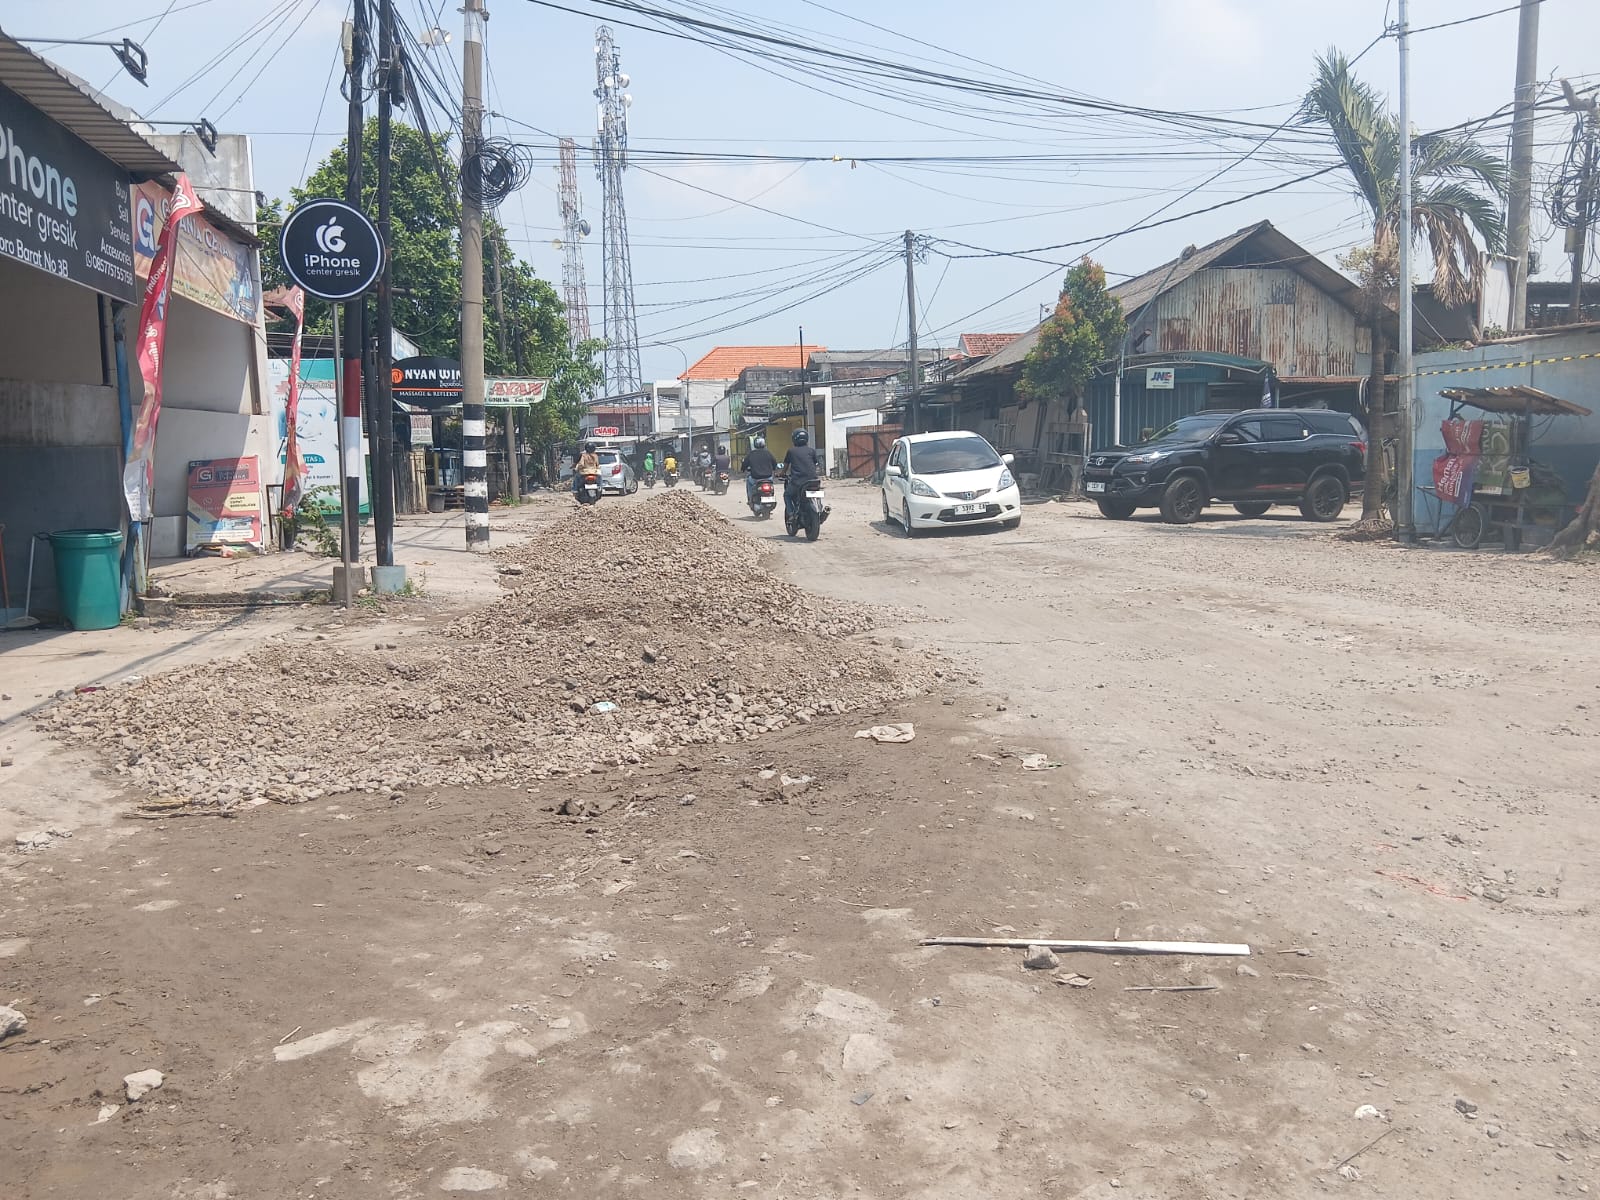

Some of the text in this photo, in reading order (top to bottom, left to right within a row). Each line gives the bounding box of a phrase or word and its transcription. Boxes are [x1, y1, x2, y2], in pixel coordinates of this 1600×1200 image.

[0, 122, 78, 217] hone
[115, 180, 128, 204] Buy
[0, 192, 78, 250] nter gresik
[118, 204, 129, 223] Sell
[108, 220, 131, 245] Service
[16, 239, 42, 267] Barat
[57, 260, 69, 278] 3B
[100, 237, 132, 266] Accessories
[304, 254, 361, 268] iPhone
[306, 268, 361, 277] center gresik
[405, 369, 437, 380] NYAN
[1150, 371, 1173, 382] JNE
